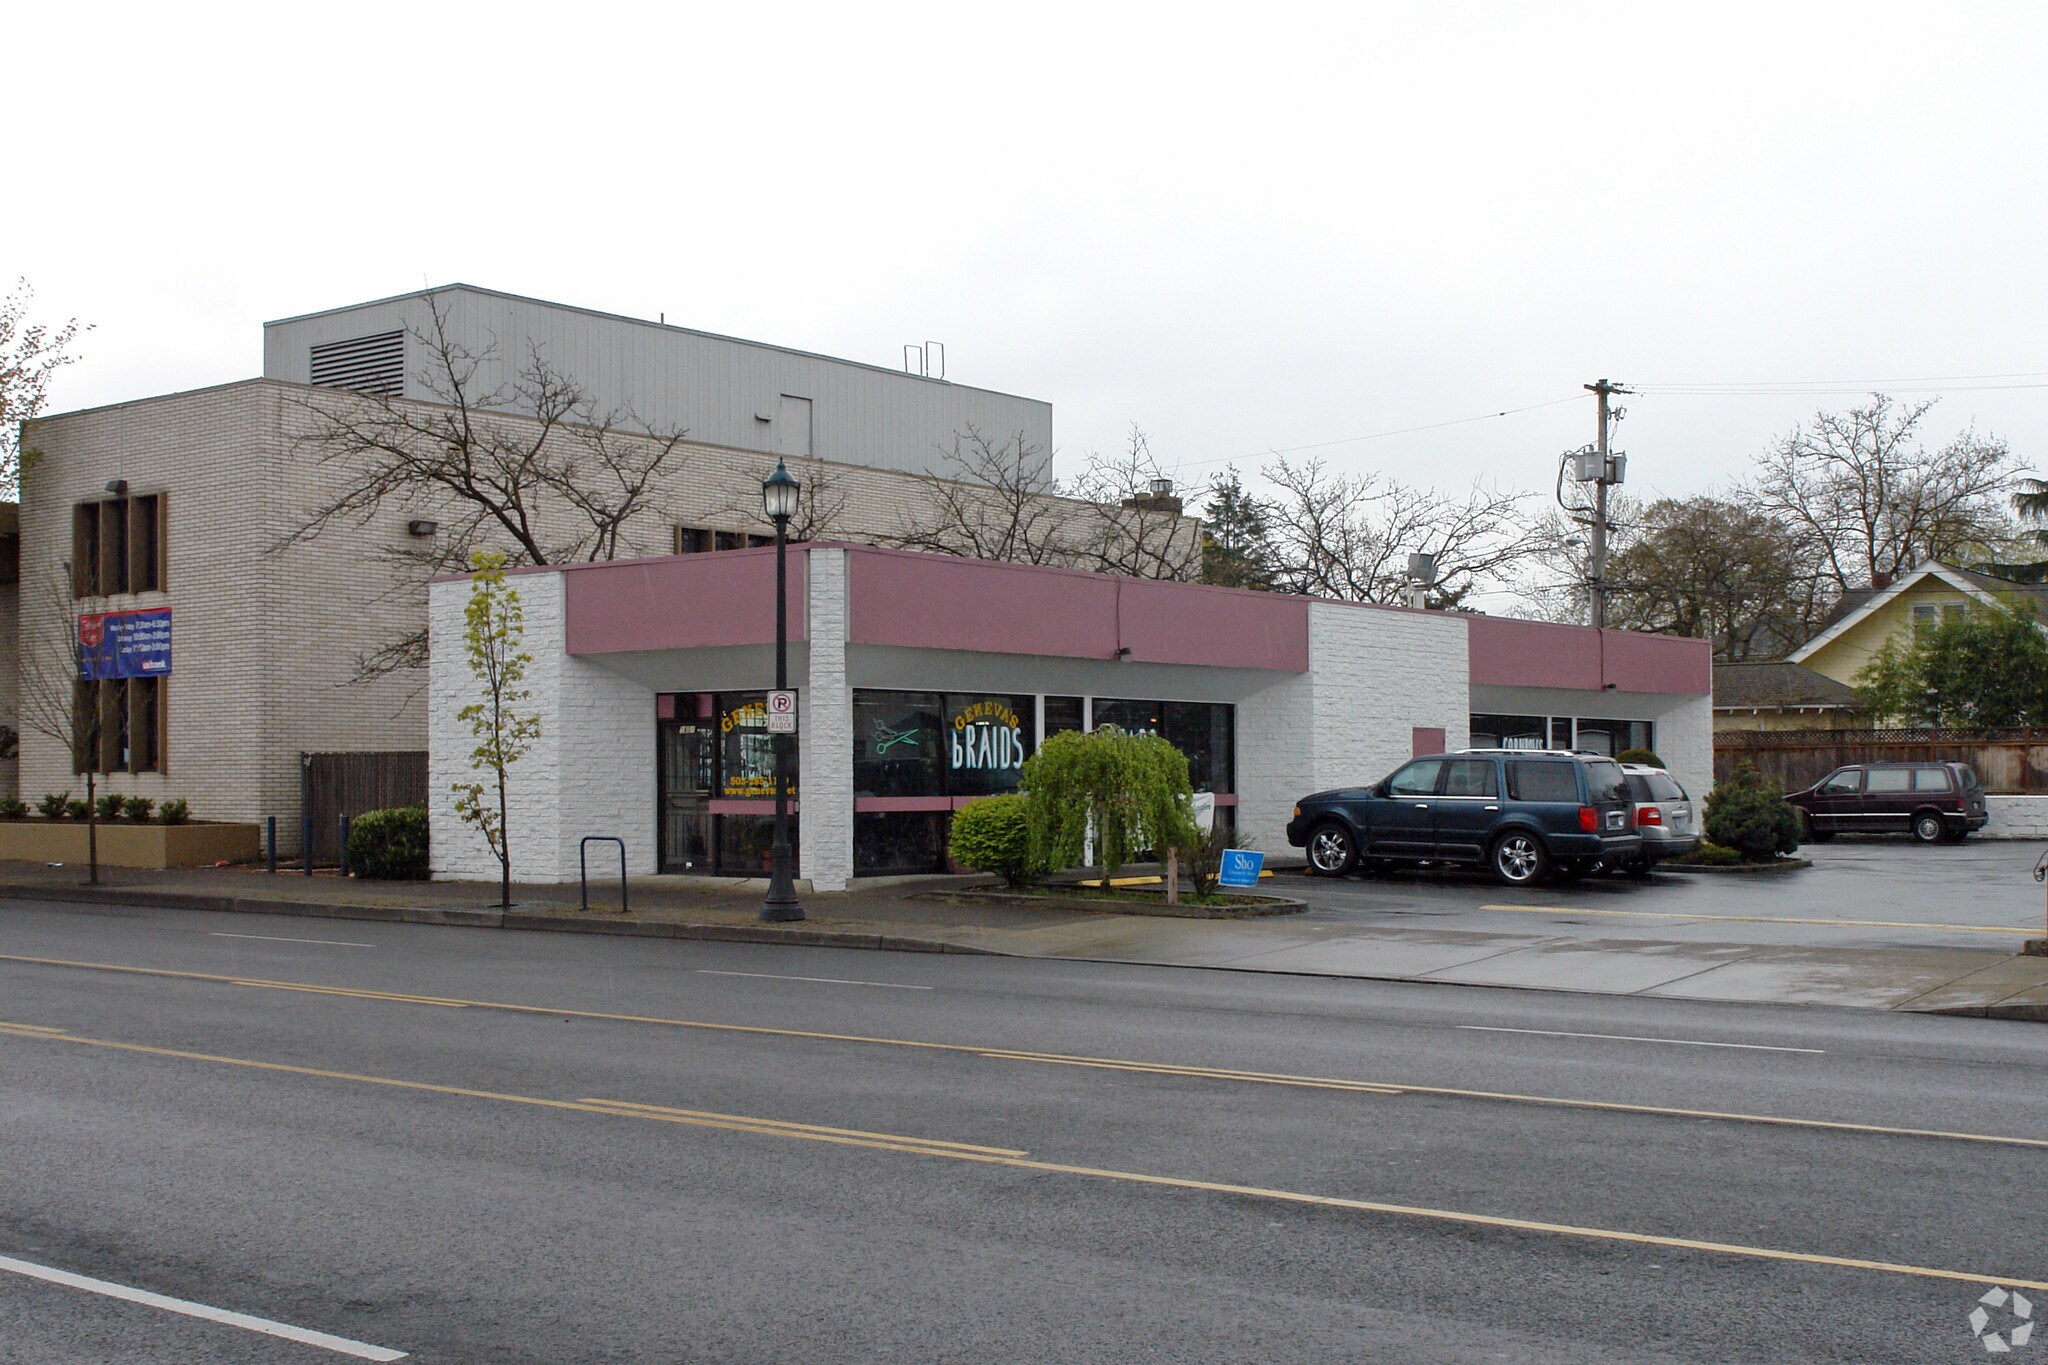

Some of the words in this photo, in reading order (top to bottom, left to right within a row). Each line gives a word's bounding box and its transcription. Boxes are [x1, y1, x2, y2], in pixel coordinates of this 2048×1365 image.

[955, 701, 1020, 730] GENEVA'S
[771, 721, 792, 729] BLOCK
[1234, 854, 1255, 870] Sho
